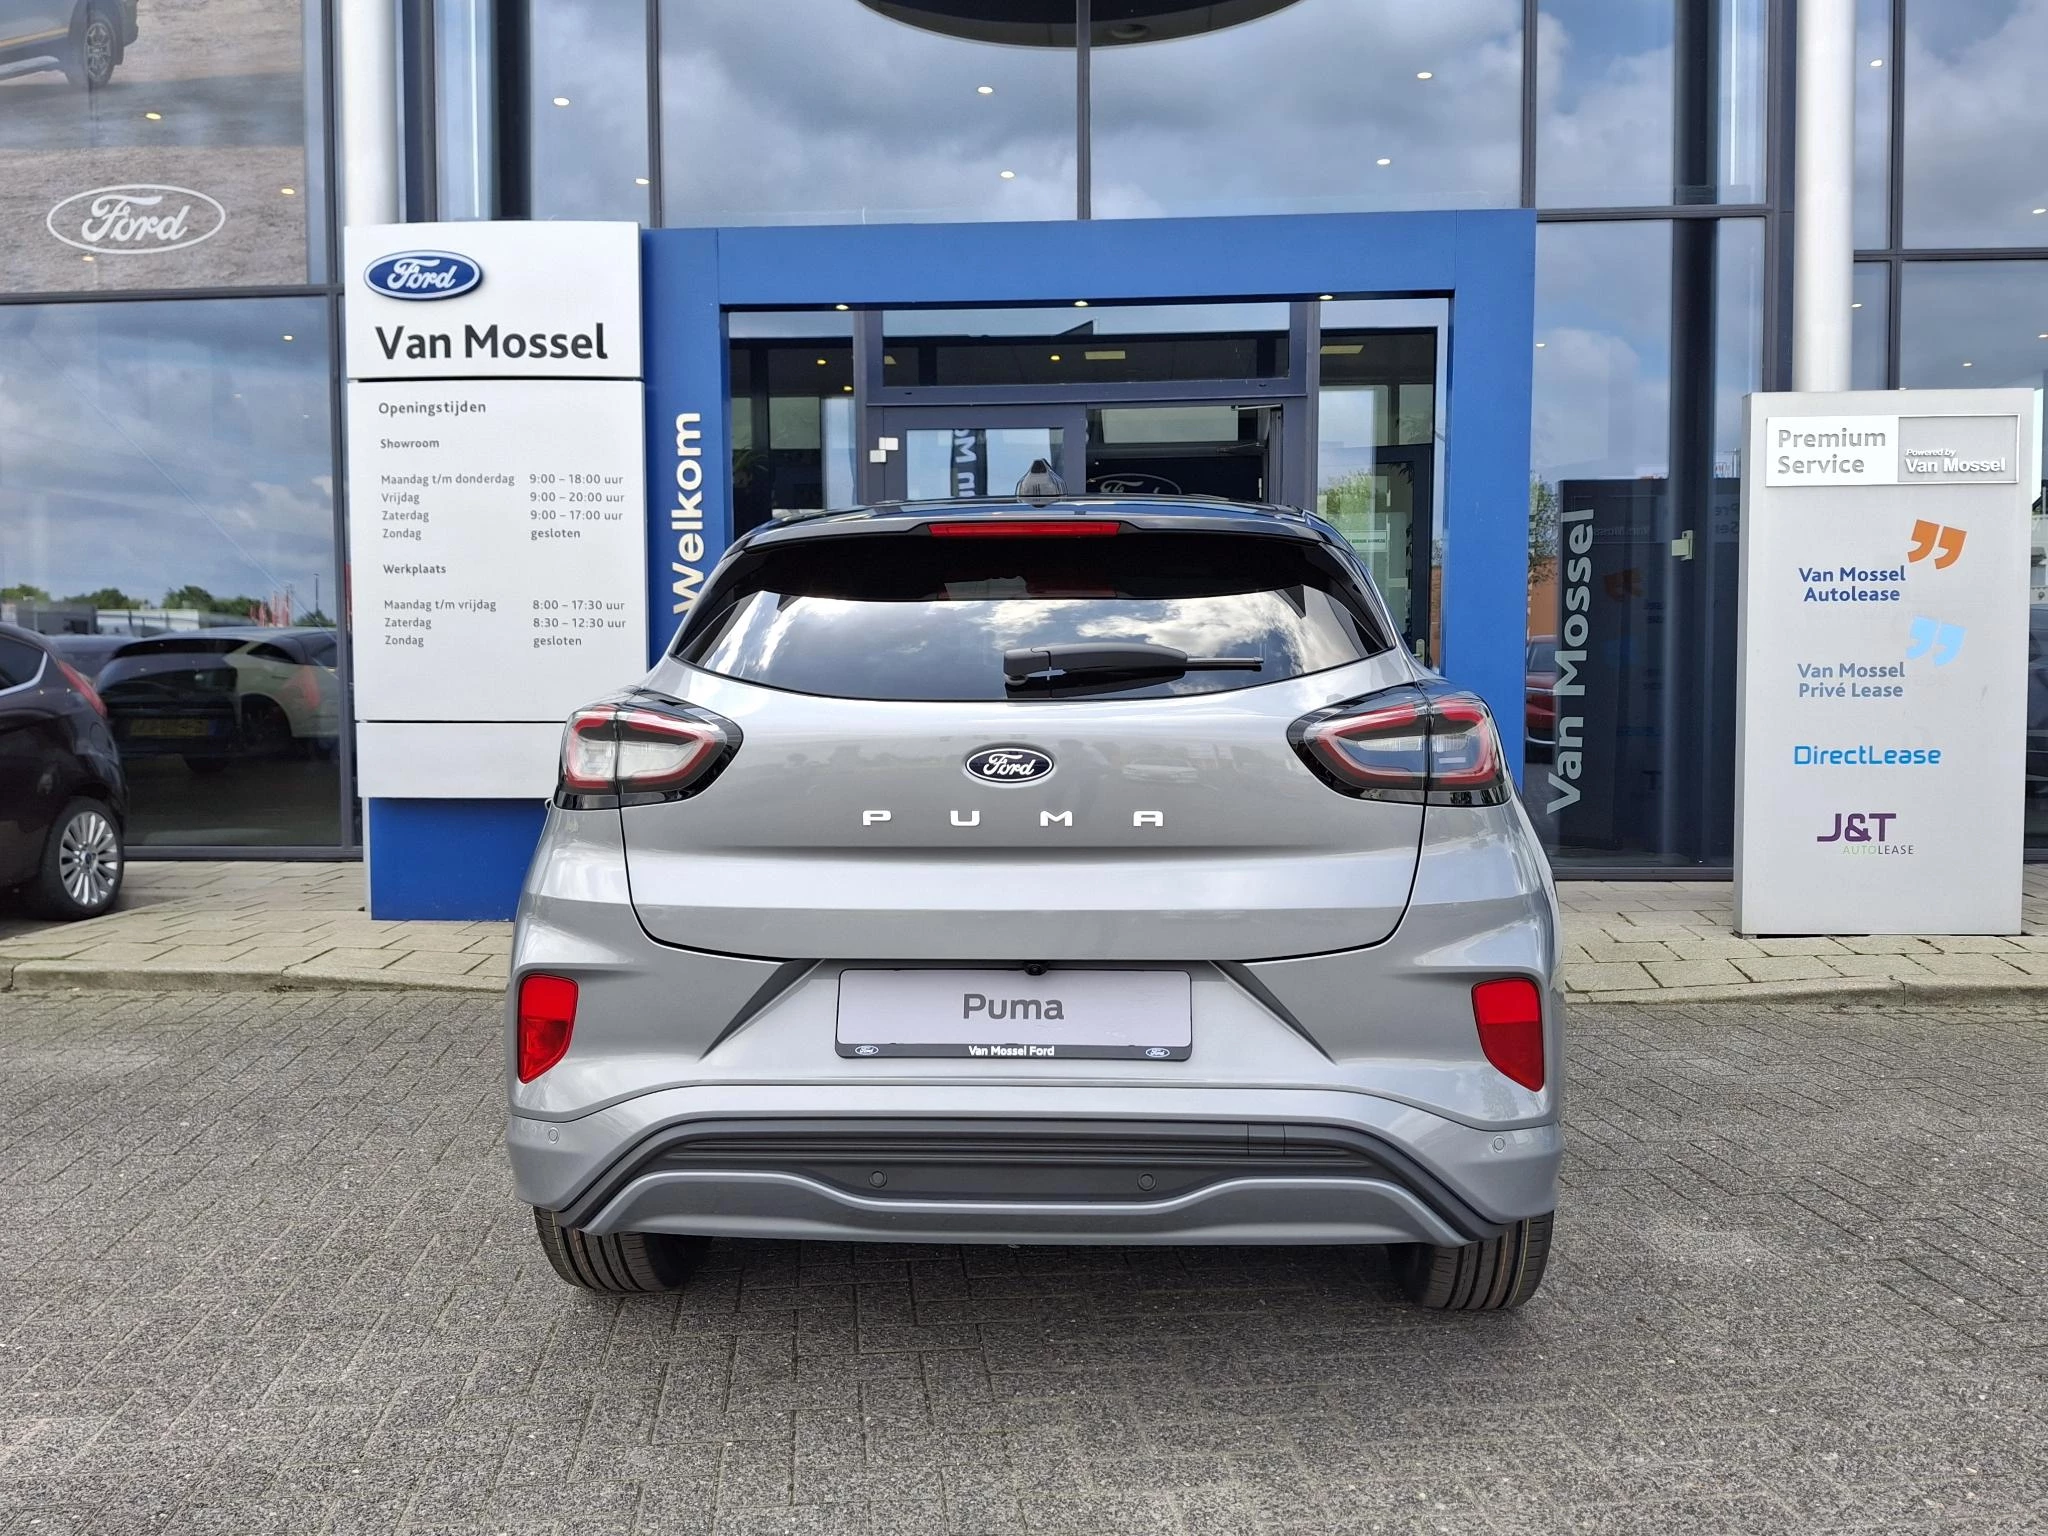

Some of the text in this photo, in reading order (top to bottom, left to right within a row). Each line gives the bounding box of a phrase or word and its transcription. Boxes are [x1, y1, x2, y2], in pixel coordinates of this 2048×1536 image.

[82, 195, 190, 242] Ford
[387, 259, 458, 290] Ford
[375, 323, 608, 360] Van Mossel
[378, 400, 487, 417] Openingstijden
[379, 438, 440, 450] Showroom
[1778, 427, 1886, 449] Premium
[1905, 447, 1957, 458] Powered by
[1777, 454, 1865, 475] Service
[1905, 457, 2006, 473] Van Mossel
[381, 474, 429, 488] Maandag
[431, 473, 452, 485] t/m
[455, 472, 515, 487] donderdag
[529, 473, 556, 485] 9:00
[569, 473, 601, 485] 18:00
[604, 476, 624, 485] uur
[380, 492, 421, 506] Vrijdag
[529, 491, 556, 503] 9:00
[569, 491, 603, 503] 20:00
[605, 494, 625, 503] uur
[381, 510, 430, 523] Zaterdag
[529, 509, 557, 521] 9:00
[570, 509, 601, 521] 17:00
[604, 512, 624, 521] uur
[671, 412, 704, 615] Welkom
[382, 527, 581, 541] Zondag gesloten
[383, 563, 447, 577] Werkplaats
[1798, 565, 1907, 583] Van Mossel
[1803, 586, 1901, 603] Autolease
[384, 599, 432, 613] Maandag
[434, 599, 456, 611] t/m
[458, 598, 497, 613] vrijdag
[532, 599, 559, 611] 8:00
[571, 599, 603, 611] 17:30
[605, 602, 626, 611] uur
[384, 617, 432, 631] Zaterdag
[532, 617, 559, 629] 8:30
[571, 617, 604, 629] 12:30
[607, 620, 627, 629] uur
[384, 634, 582, 648] Zondag gesloten
[1547, 509, 1594, 815] Van Mossel
[1796, 662, 1906, 679] Van Mossel
[1798, 682, 1904, 698] Privé Lease
[1793, 745, 1942, 765] DirectLease
[983, 753, 1036, 775] Ford
[862, 809, 1164, 827] PUMA
[1816, 812, 1897, 842] J&T
[1842, 844, 1916, 855] AUTOLEASE
[963, 993, 1065, 1021] Puma
[968, 1045, 1055, 1056] Van Mossel Ford
